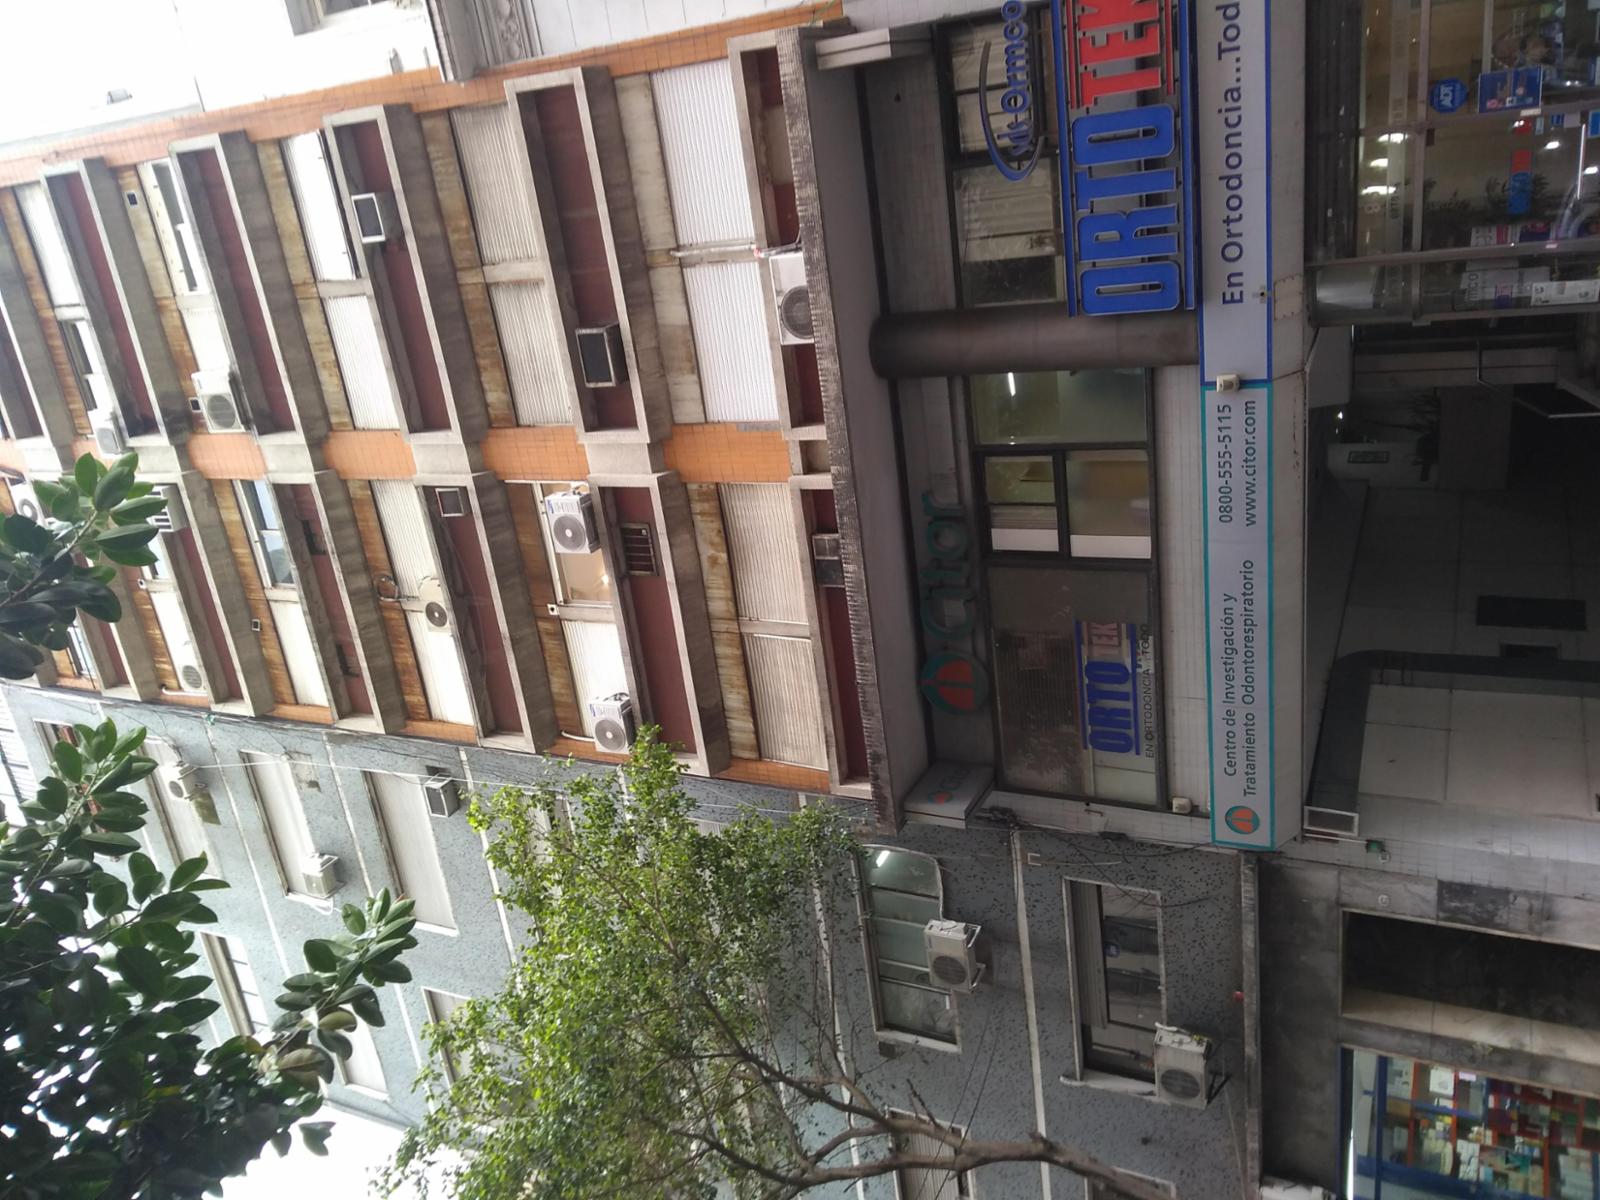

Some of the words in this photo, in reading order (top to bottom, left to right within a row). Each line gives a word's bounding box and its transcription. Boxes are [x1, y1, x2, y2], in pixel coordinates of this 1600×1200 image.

[999, 0, 1032, 114] Ormco
[1439, 83, 1453, 107] ADT
[1221, 271, 1244, 305] En
[1216, 403, 1234, 524] 0800-555-5115
[1241, 400, 1257, 527] www.citor.com
[1222, 592, 1239, 603] y
[1218, 606, 1239, 705] Investigación
[1236, 559, 1259, 706] Odontorespiratorio
[1144, 743, 1155, 759] EN
[1221, 708, 1236, 727] de
[1223, 729, 1237, 777] Centro
[1241, 712, 1257, 798] Tratamiento
